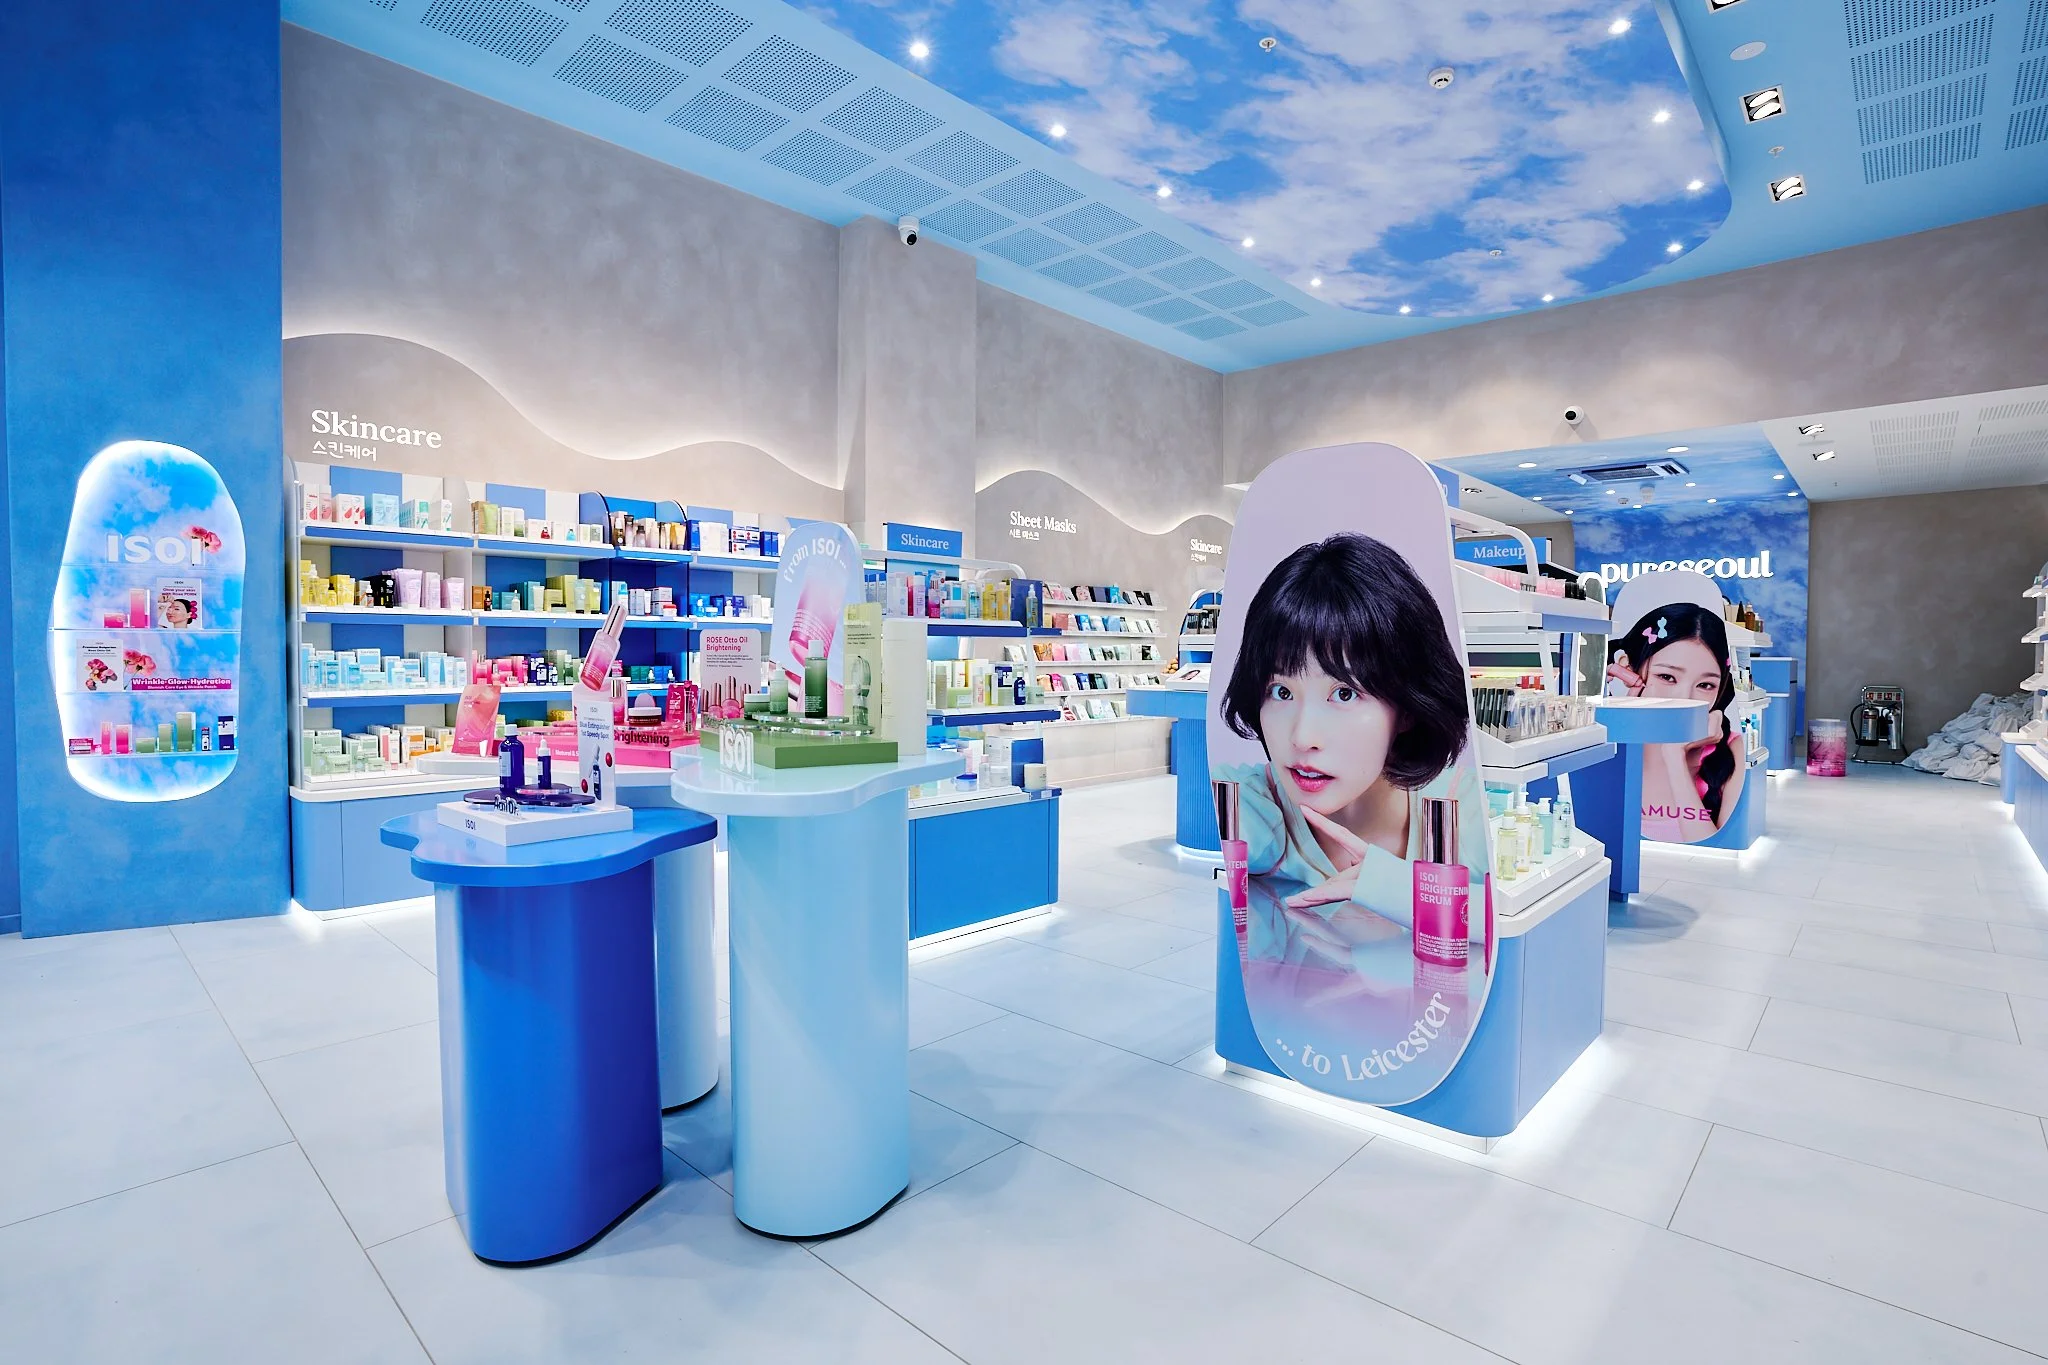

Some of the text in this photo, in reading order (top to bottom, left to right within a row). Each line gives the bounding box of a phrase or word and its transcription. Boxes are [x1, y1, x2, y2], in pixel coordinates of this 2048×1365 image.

[311, 409, 442, 449] Skincare
[312, 440, 377, 462] 스킨케어
[1010, 510, 1077, 534] Sheet Masks
[107, 534, 202, 565] ISOI
[901, 533, 949, 550] Skincare
[1190, 538, 1223, 555] Skincare
[1473, 545, 1526, 560] Makeup
[706, 636, 748, 644] ROSE Otto Oil
[706, 644, 742, 652] Brightening
[719, 725, 753, 776] ISOI
[1419, 871, 1438, 883] ISOI
[1419, 893, 1452, 906] SERUM
[1301, 1043, 1331, 1075] to
[1341, 991, 1451, 1081] Leicester
